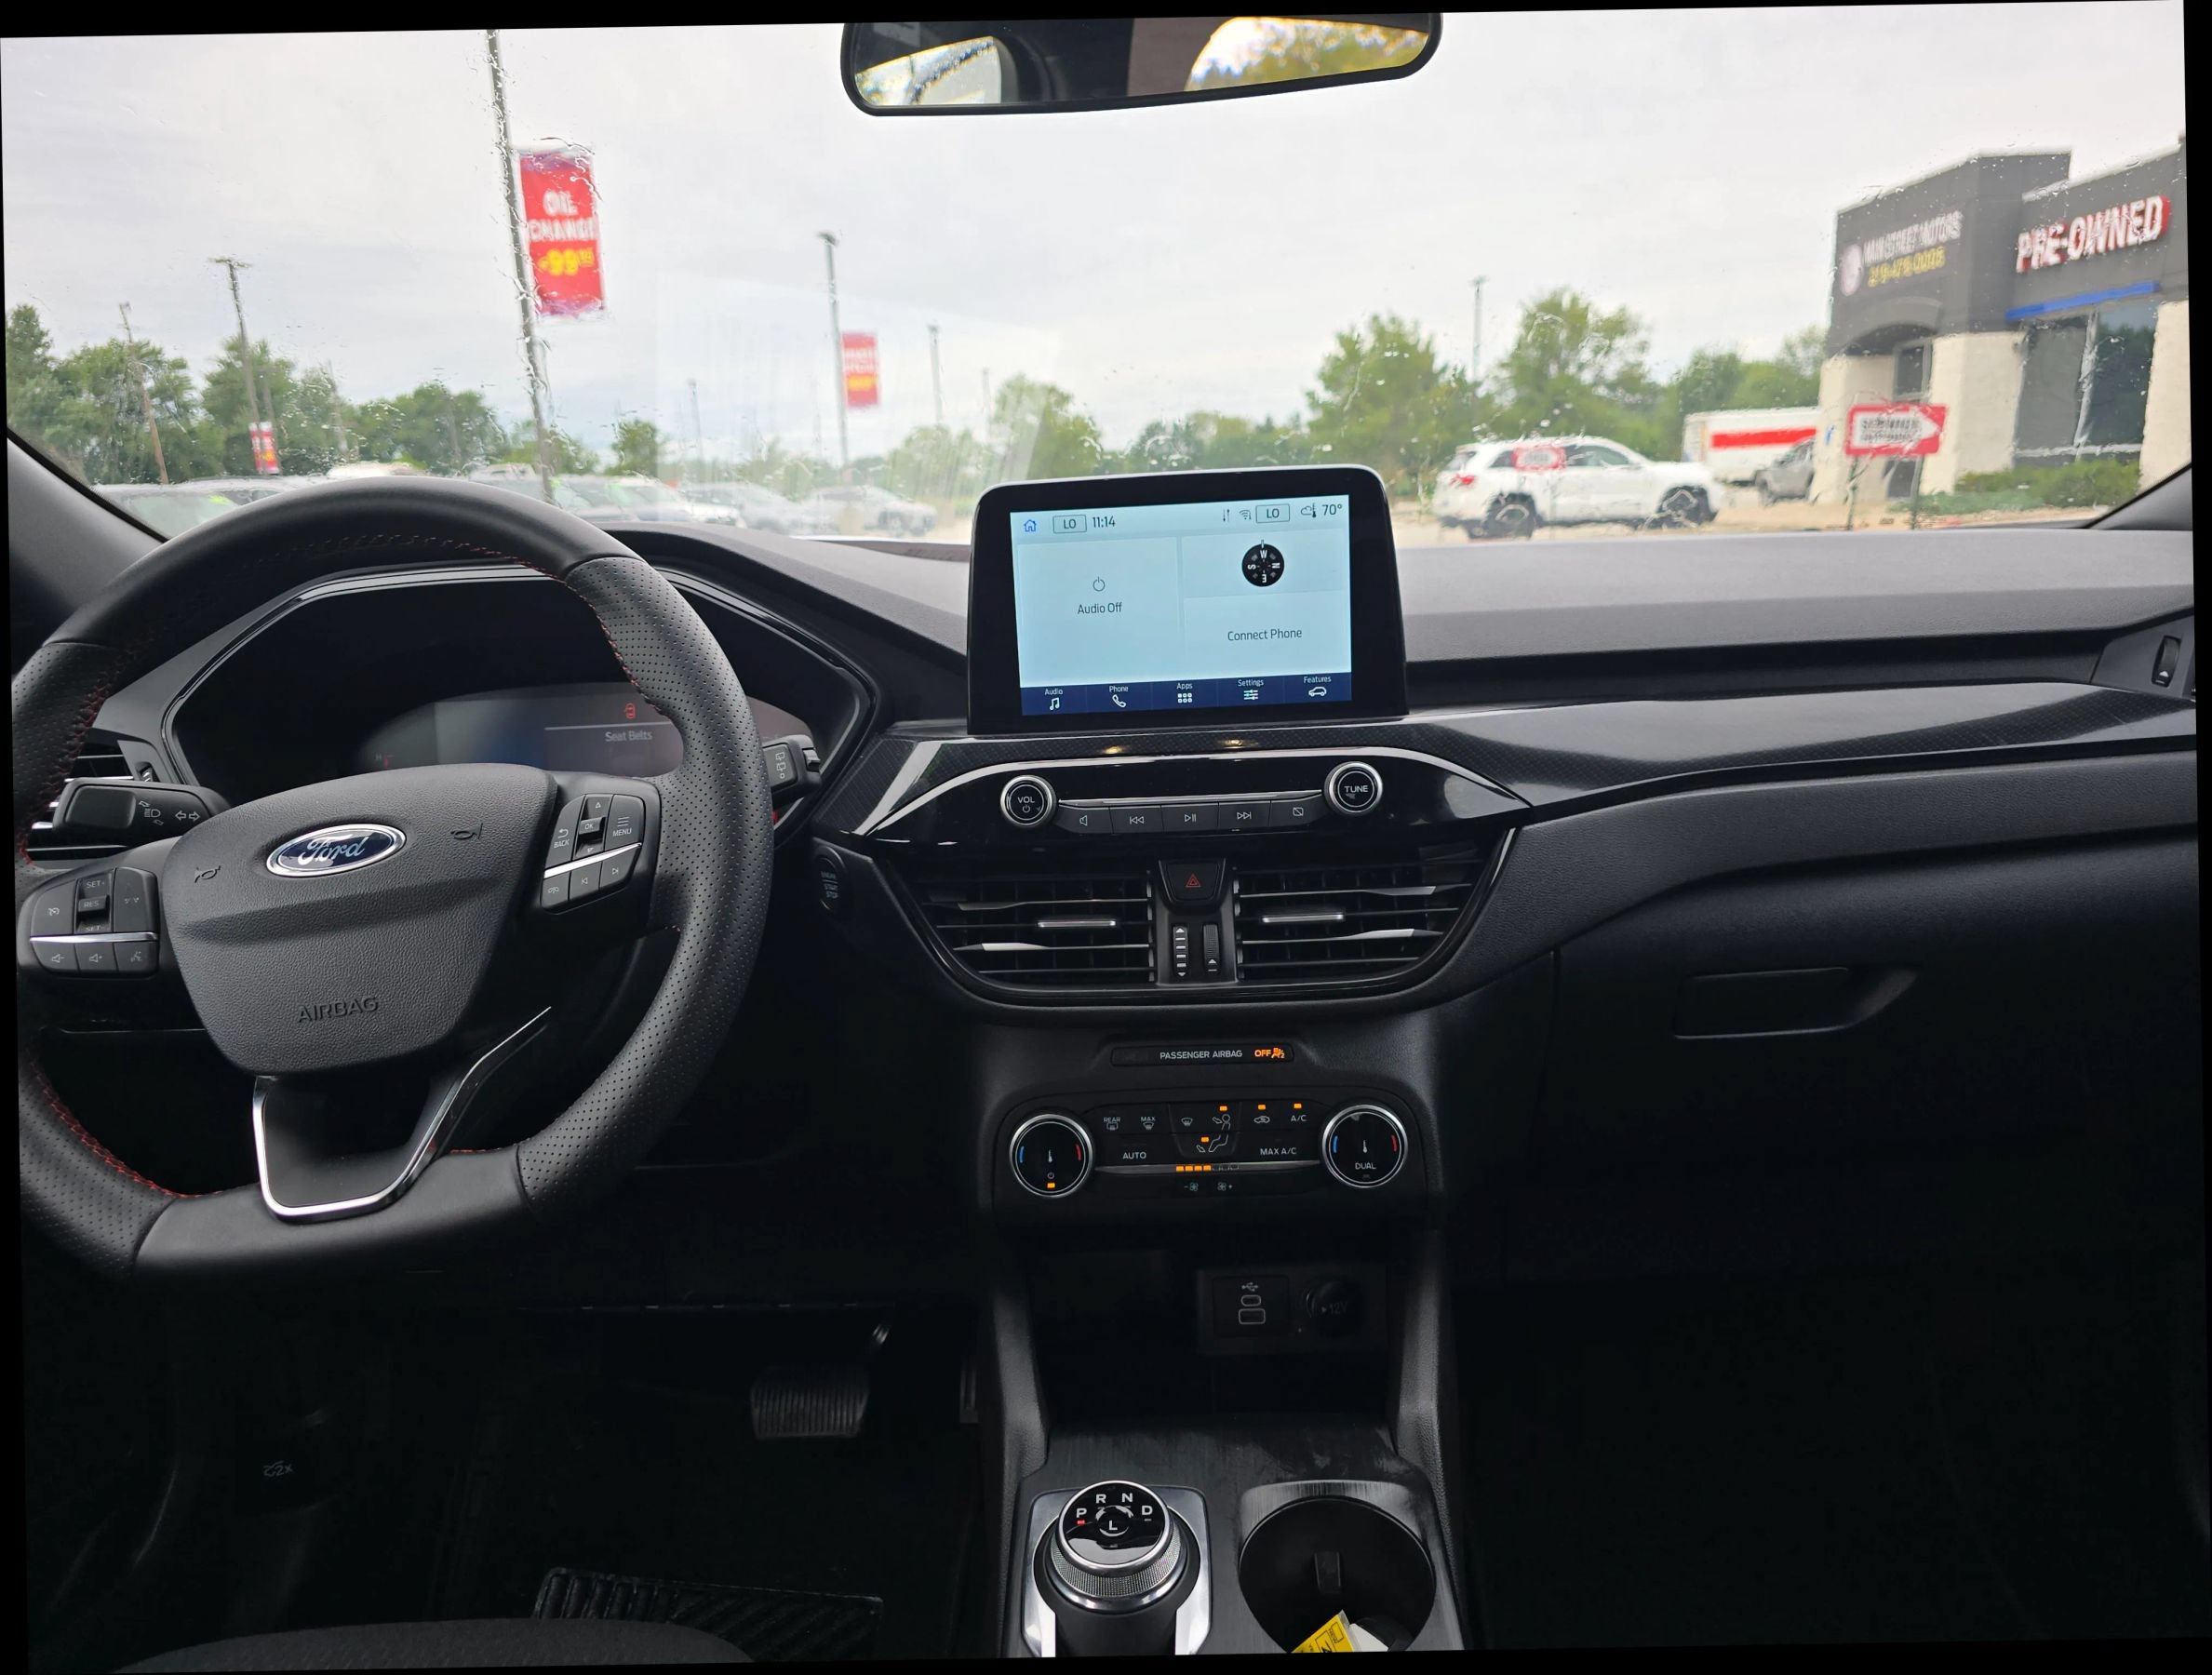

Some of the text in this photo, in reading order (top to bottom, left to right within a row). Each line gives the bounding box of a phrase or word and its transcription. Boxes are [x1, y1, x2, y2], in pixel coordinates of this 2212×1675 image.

[543, 189, 578, 217] OIL
[2016, 194, 2171, 274] PRE-OWNED
[1266, 508, 1280, 519] LO
[1321, 503, 1343, 516] 70°
[1063, 516, 1116, 529] LO 11:14
[1259, 549, 1267, 559] W
[1077, 601, 1123, 615] Audio Off
[1227, 628, 1303, 641] Connect Phone
[1237, 678, 1265, 688] Settings
[1303, 675, 1332, 684] Features
[1044, 688, 1064, 696] Audio
[1108, 684, 1129, 693] Phone
[1176, 682, 1193, 691] Apps
[605, 730, 653, 743] Seat Belts
[1344, 784, 1369, 794] TUNE
[1017, 796, 1035, 804] VOL
[612, 828, 633, 838] MENU
[553, 838, 570, 849] BACK
[297, 833, 369, 866] Ford
[84, 900, 100, 908] RES
[298, 996, 380, 1024] AIRBAG
[1160, 1049, 1272, 1060] PASSENGER AIRBAG OFF
[1290, 1114, 1307, 1122] A/C
[1122, 1151, 1147, 1159] AUTO
[1259, 1146, 1297, 1156] MAX A/C
[1354, 1161, 1376, 1171] DUAL
[1329, 1301, 1348, 1315] 12V
[1095, 1493, 1107, 1504] R
[1121, 1493, 1133, 1503] N
[1076, 1508, 1088, 1519] P
[1141, 1505, 1153, 1516] D
[1108, 1520, 1119, 1531] L
